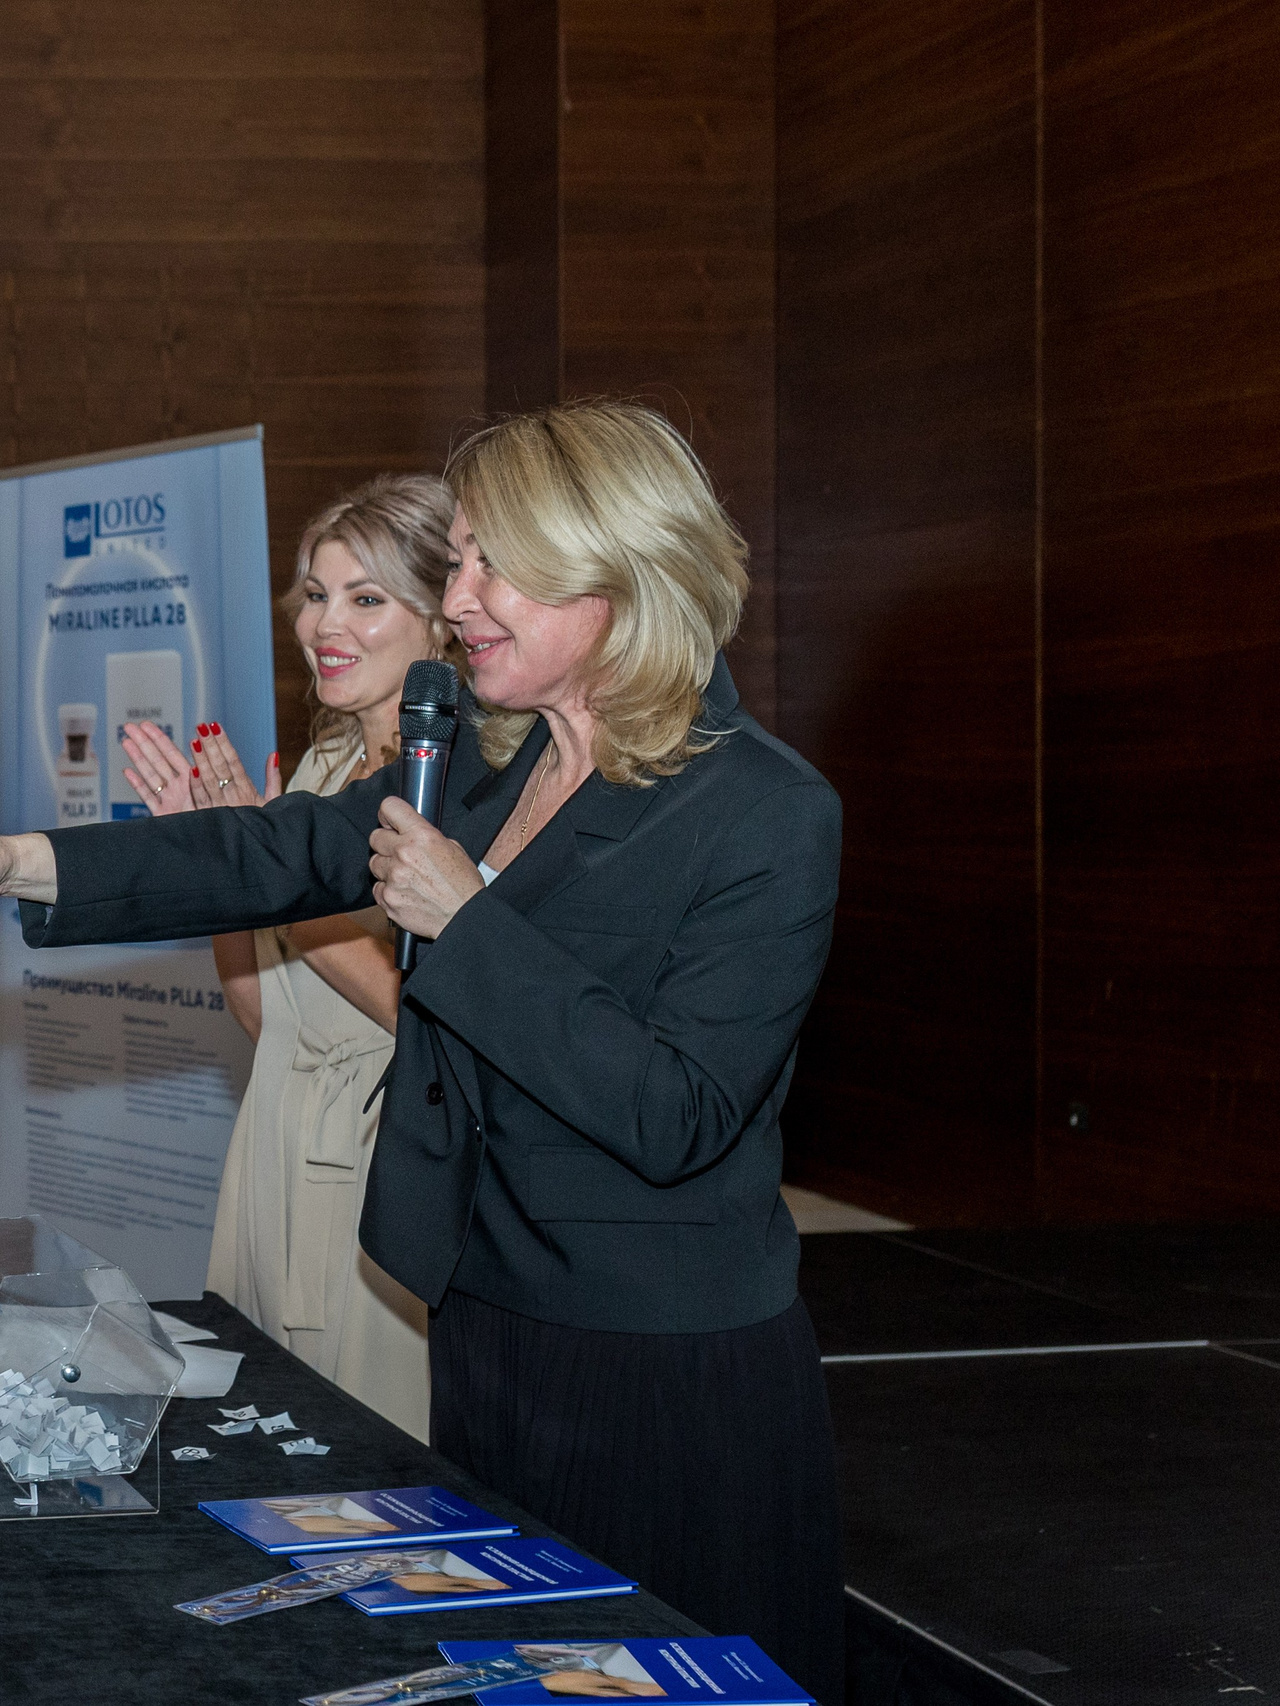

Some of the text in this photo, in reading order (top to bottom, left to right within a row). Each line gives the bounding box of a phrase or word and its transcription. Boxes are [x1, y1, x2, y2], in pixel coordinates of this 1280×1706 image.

[94, 492, 166, 538] LOTOS
[48, 602, 187, 632] MIRALINE PLLA 28
[170, 986, 205, 1009] PLLA
[208, 990, 225, 1012] 28
